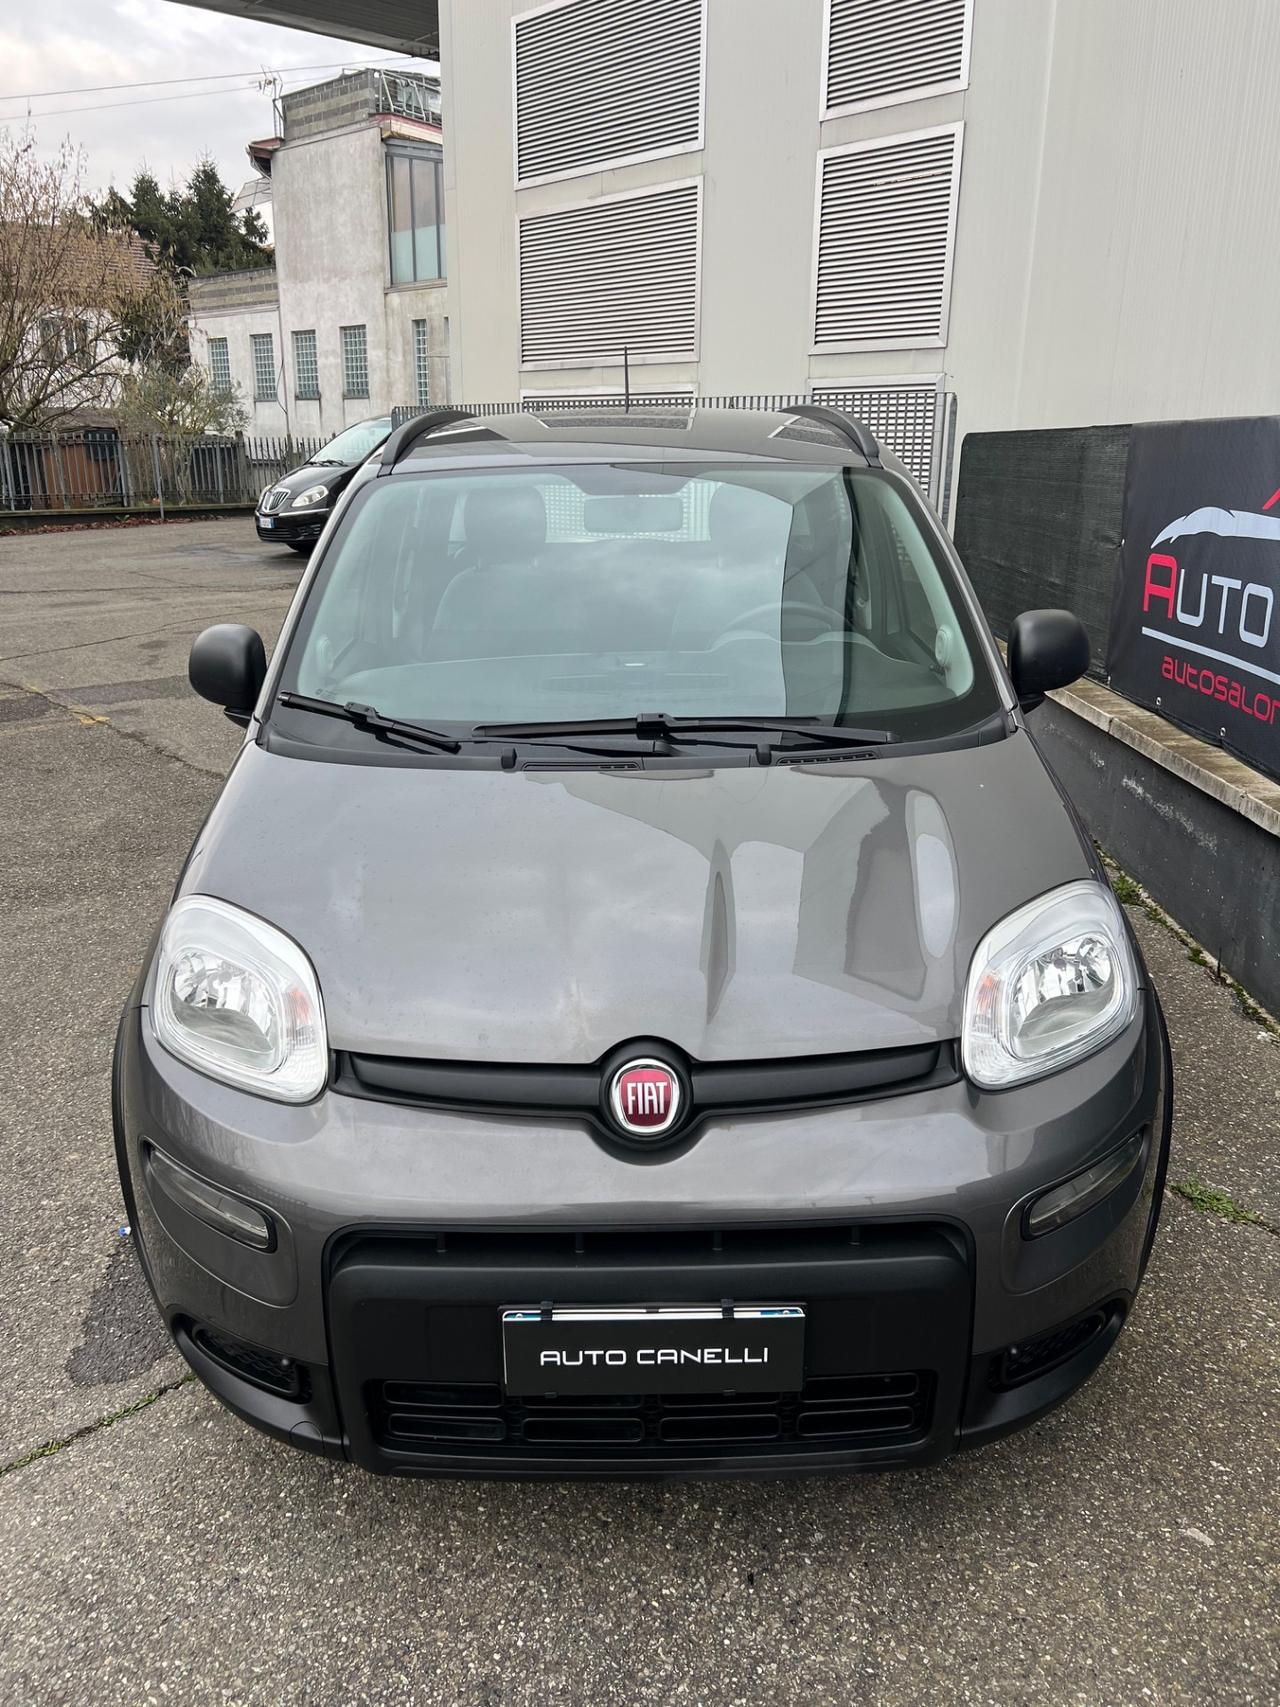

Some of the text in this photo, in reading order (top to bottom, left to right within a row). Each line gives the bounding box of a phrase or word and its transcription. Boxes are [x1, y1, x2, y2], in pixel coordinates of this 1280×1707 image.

[1143, 553, 1274, 648] AUTO
[626, 1081, 668, 1115] FIAT
[540, 1347, 769, 1366] AUTO CANELLI
